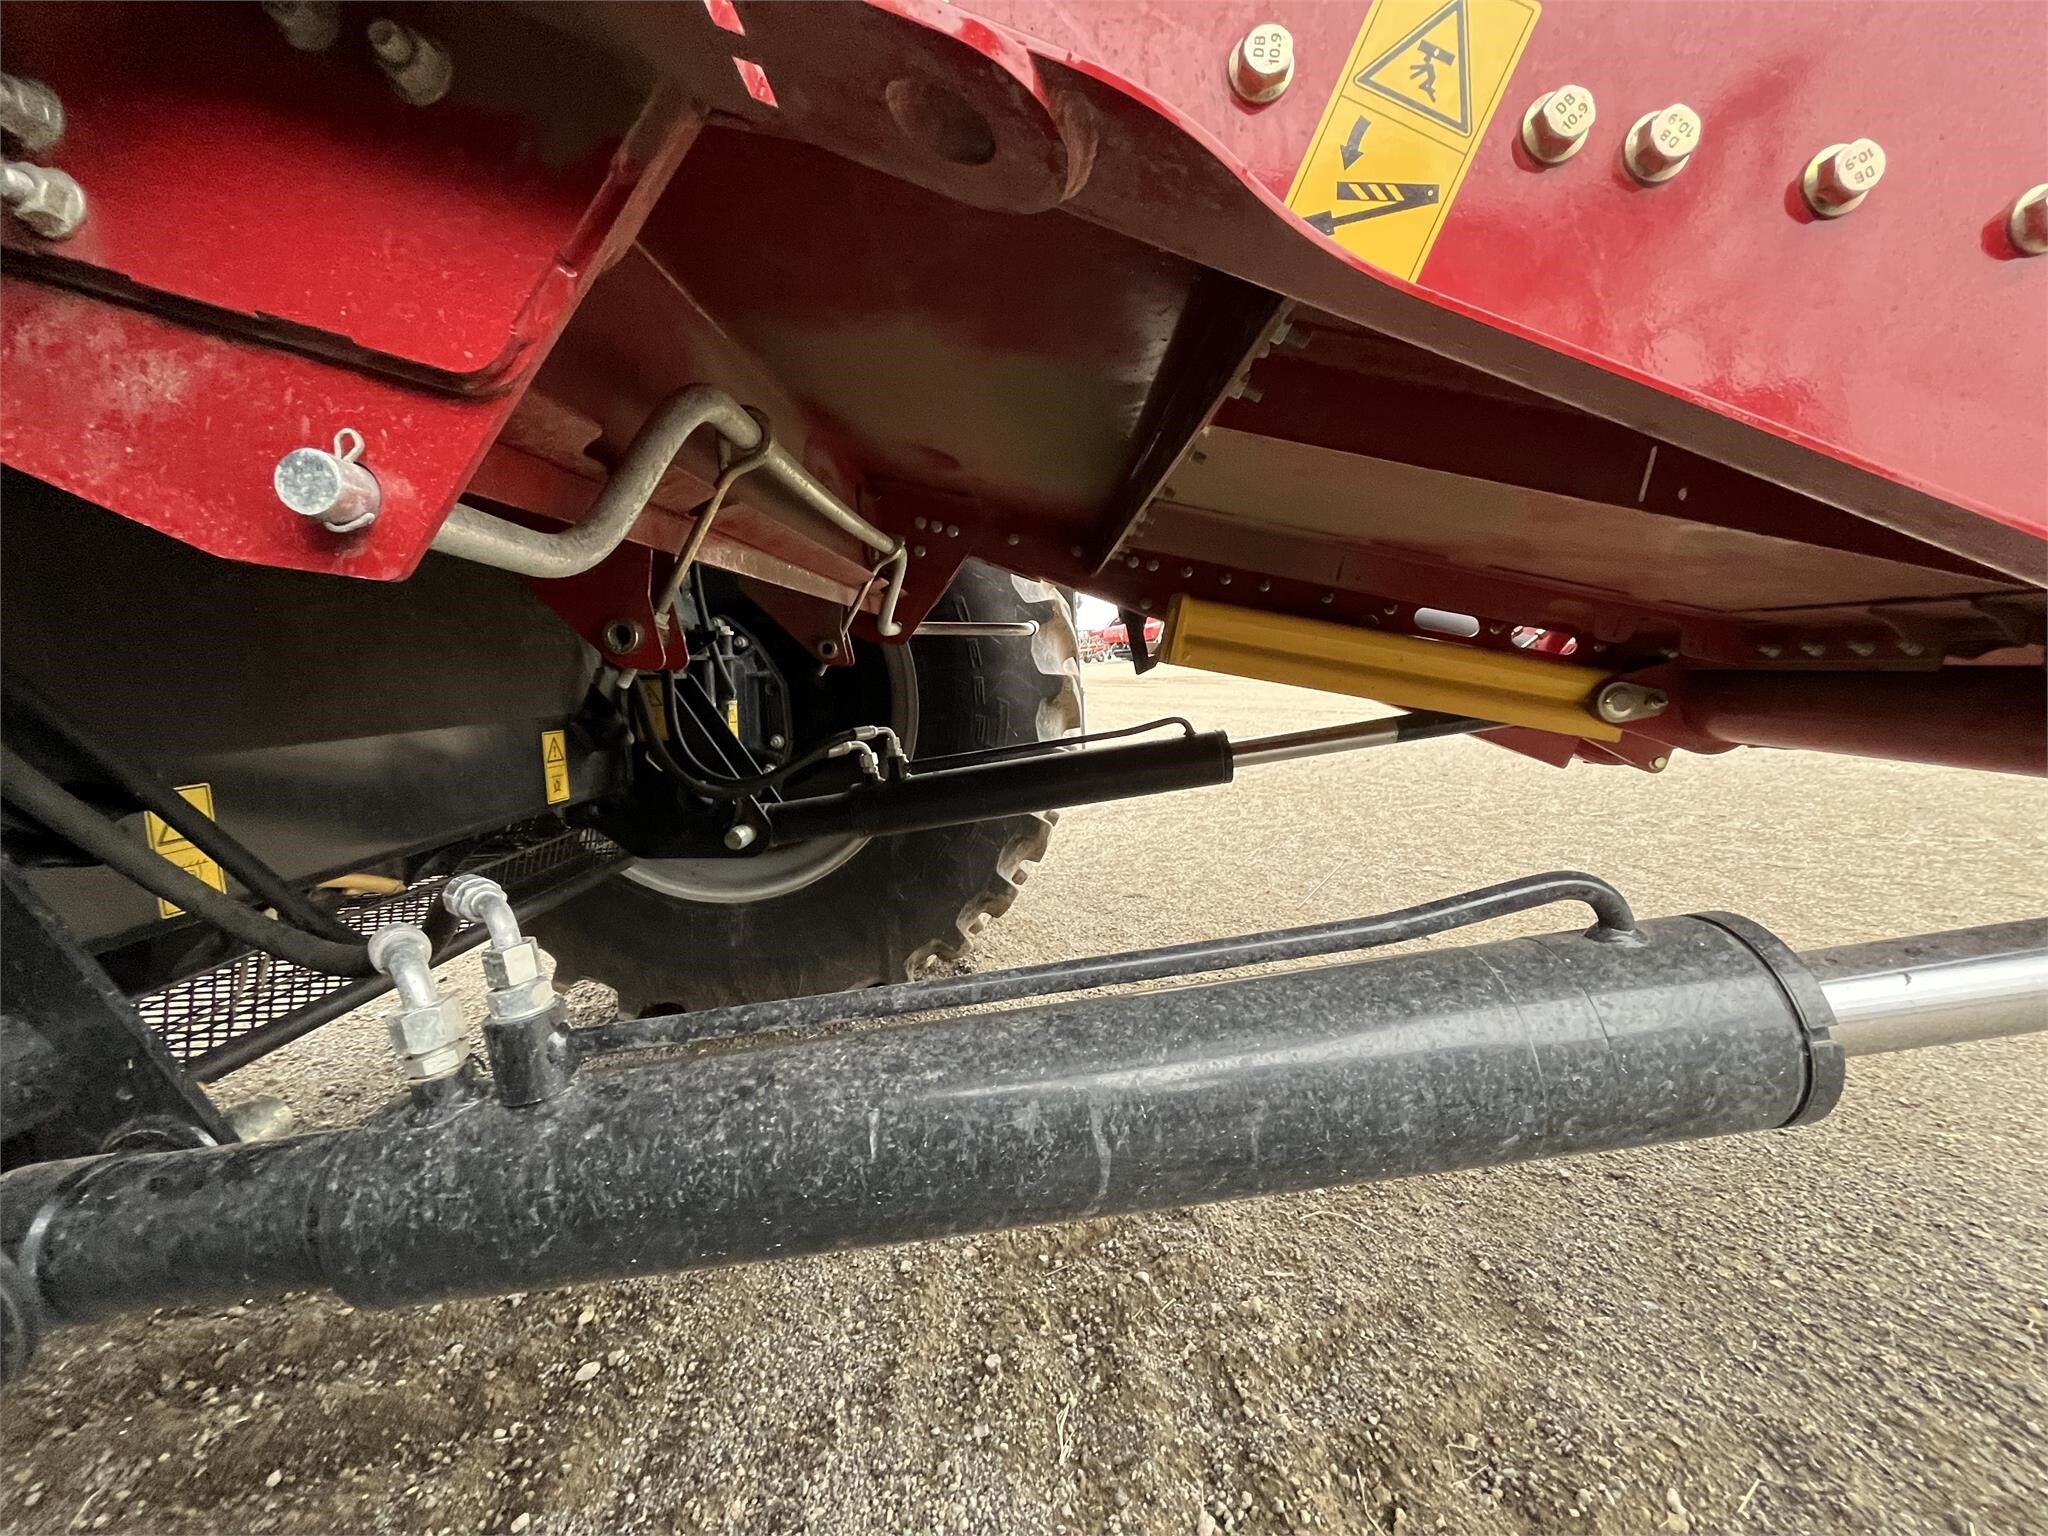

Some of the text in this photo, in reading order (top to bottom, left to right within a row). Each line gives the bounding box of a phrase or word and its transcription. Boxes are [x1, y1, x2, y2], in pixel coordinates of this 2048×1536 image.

[1253, 36, 1265, 57] DB
[1268, 33, 1282, 64] 10.9
[1556, 93, 1576, 114] DB
[1562, 102, 1588, 129] 10.9
[1668, 113, 1694, 138] 10.9
[1660, 129, 1679, 149] DB
[1845, 147, 1874, 171] 10.9
